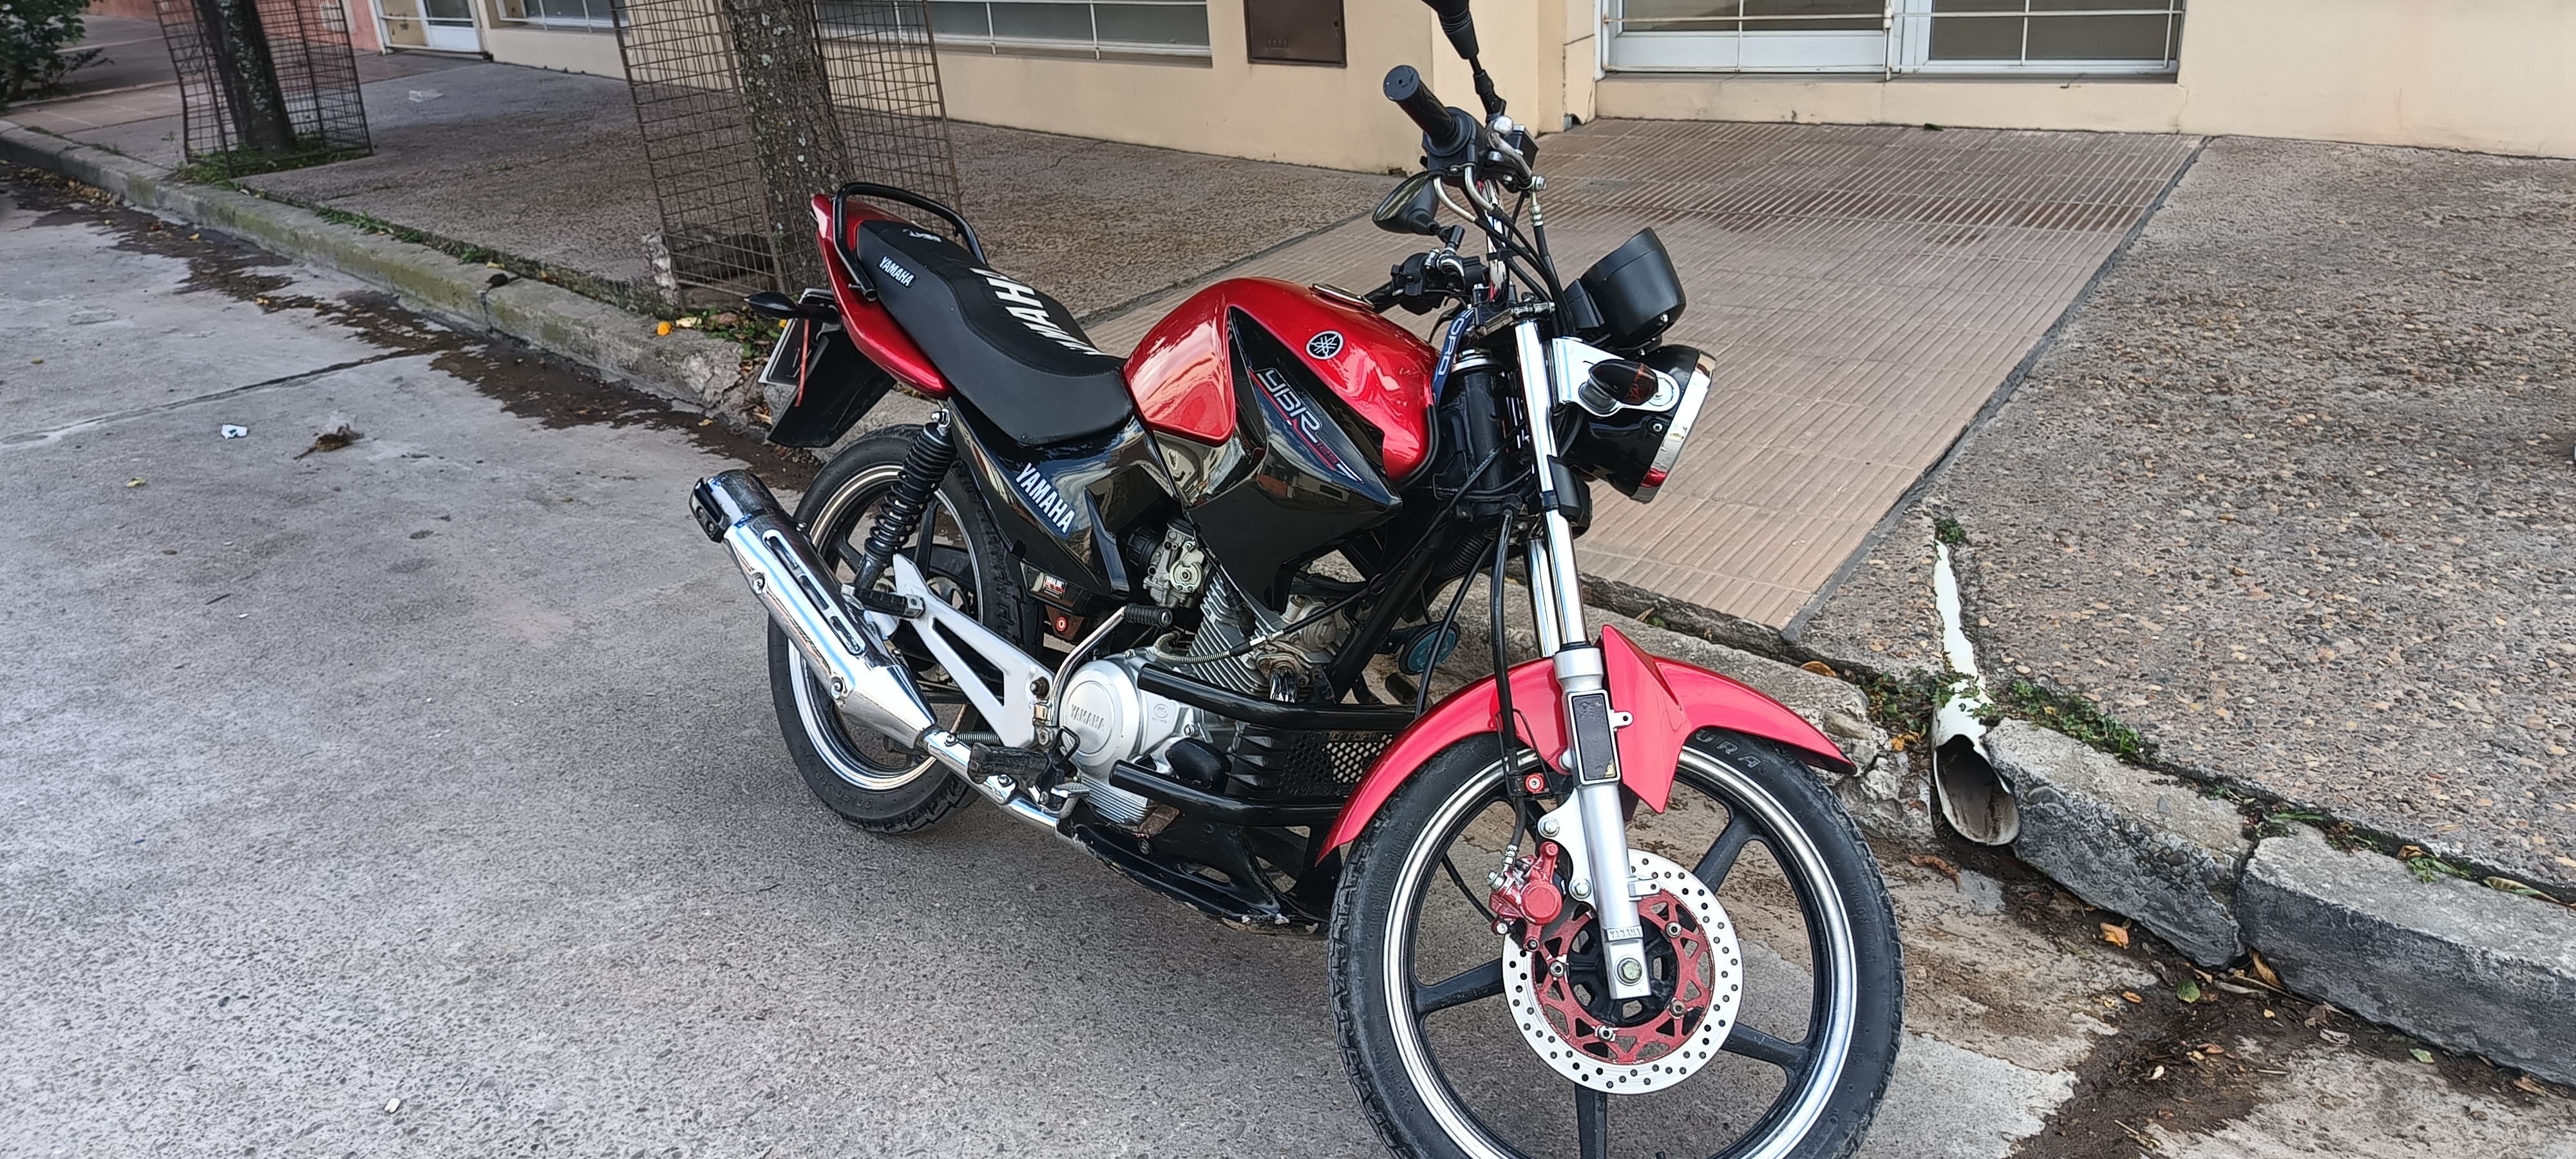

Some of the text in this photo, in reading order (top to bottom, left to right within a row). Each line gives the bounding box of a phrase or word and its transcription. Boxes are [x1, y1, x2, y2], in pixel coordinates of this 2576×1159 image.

[879, 256, 914, 287] YAMAHA
[1256, 370, 1320, 444] YBR
[1016, 462, 1075, 534] YAMAHA
[1072, 704, 1105, 733] YAMAHA
[1846, 880, 1869, 926] NYLON
[1609, 928, 1641, 939] YAMAHA
